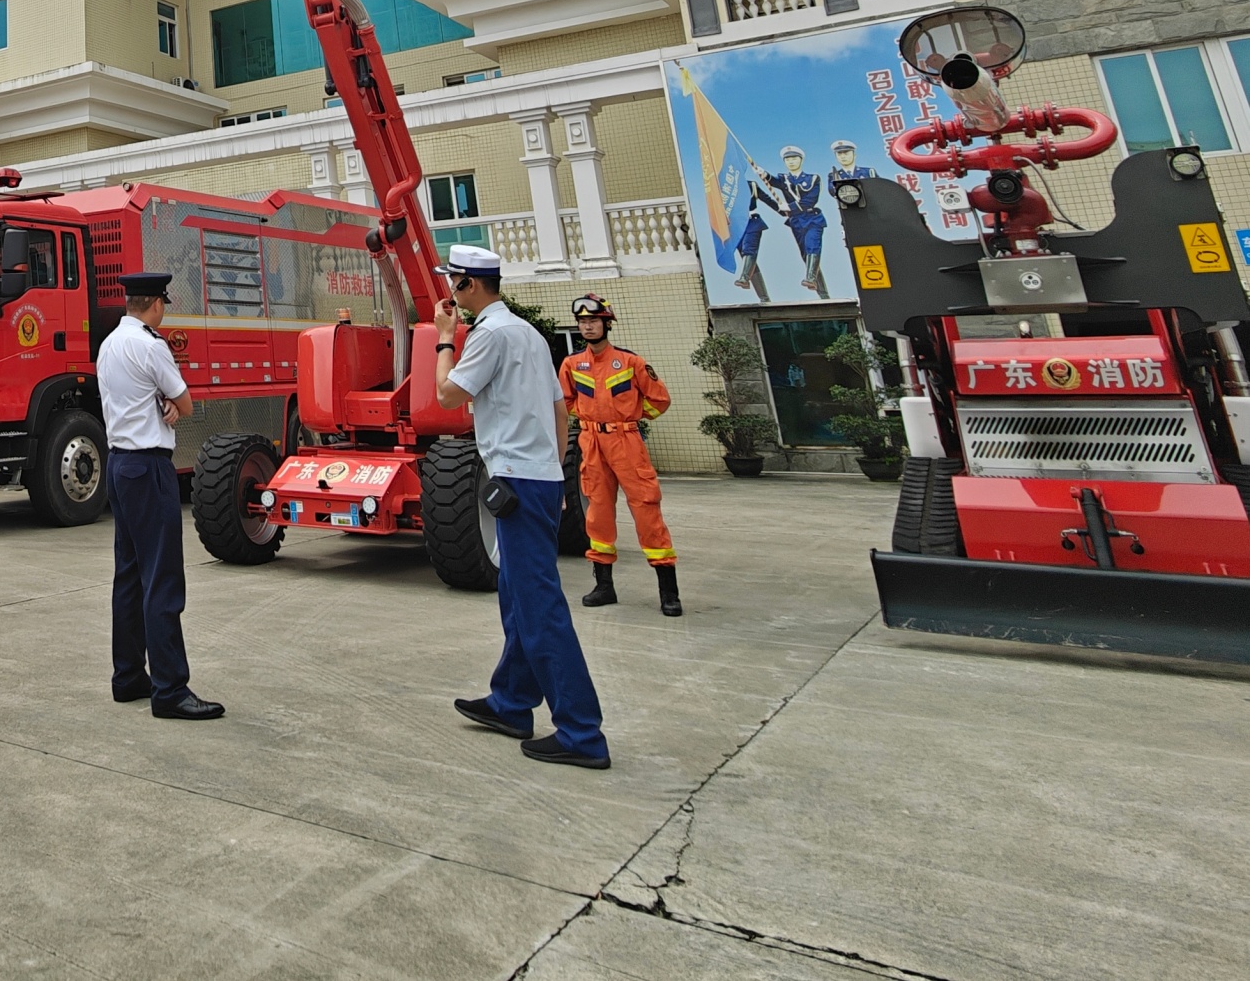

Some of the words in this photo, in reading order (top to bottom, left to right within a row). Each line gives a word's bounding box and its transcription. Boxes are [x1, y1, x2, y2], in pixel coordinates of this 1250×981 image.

[327, 270, 373, 296] 消防救援
[968, 360, 1037, 389] 广东
[1087, 357, 1164, 388] 消防
[277, 461, 319, 479] 广东
[350, 464, 393, 485] 消防
